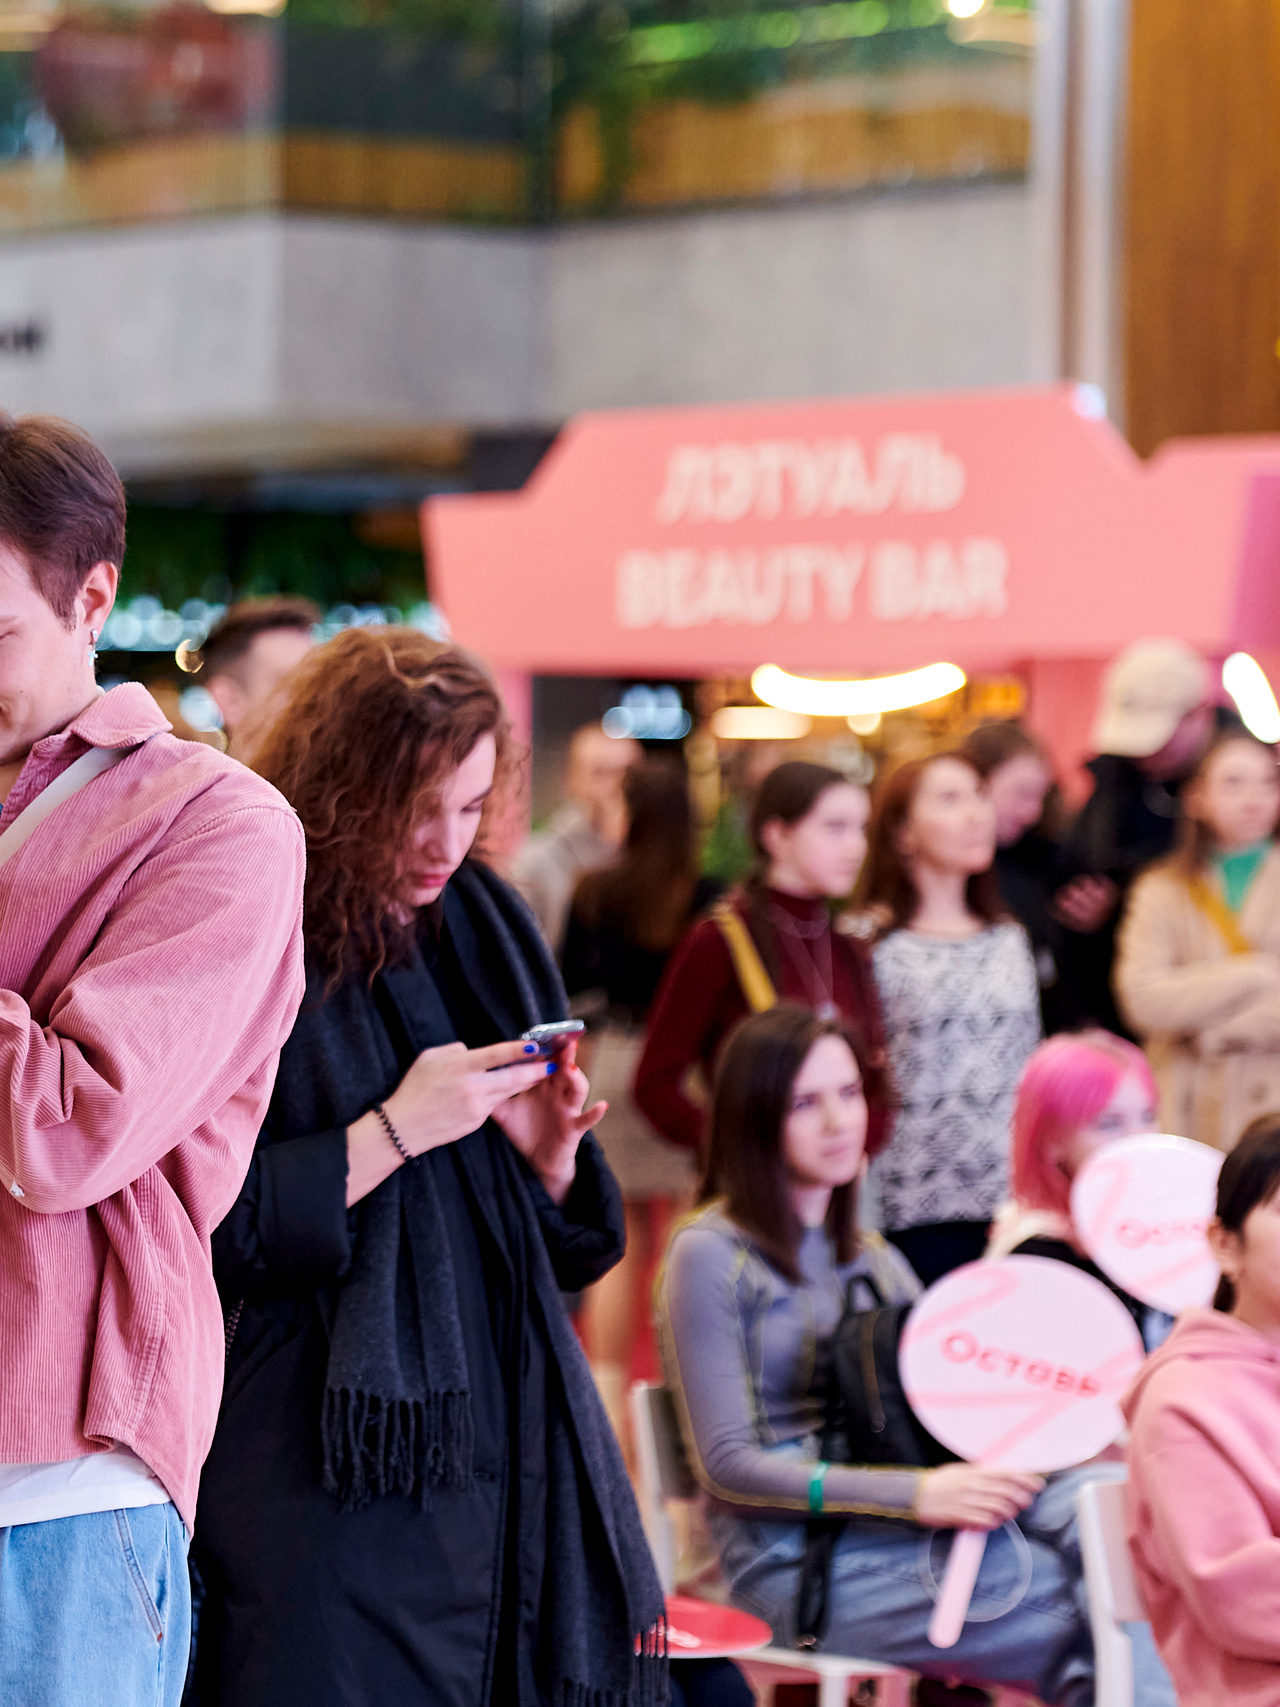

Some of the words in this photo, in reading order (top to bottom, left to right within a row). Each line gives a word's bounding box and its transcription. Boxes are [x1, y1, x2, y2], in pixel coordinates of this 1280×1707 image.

[658, 433, 964, 524] ЛЭТУАЛЬ
[619, 546, 866, 629] BEAUTY
[873, 539, 1007, 621] BAR
